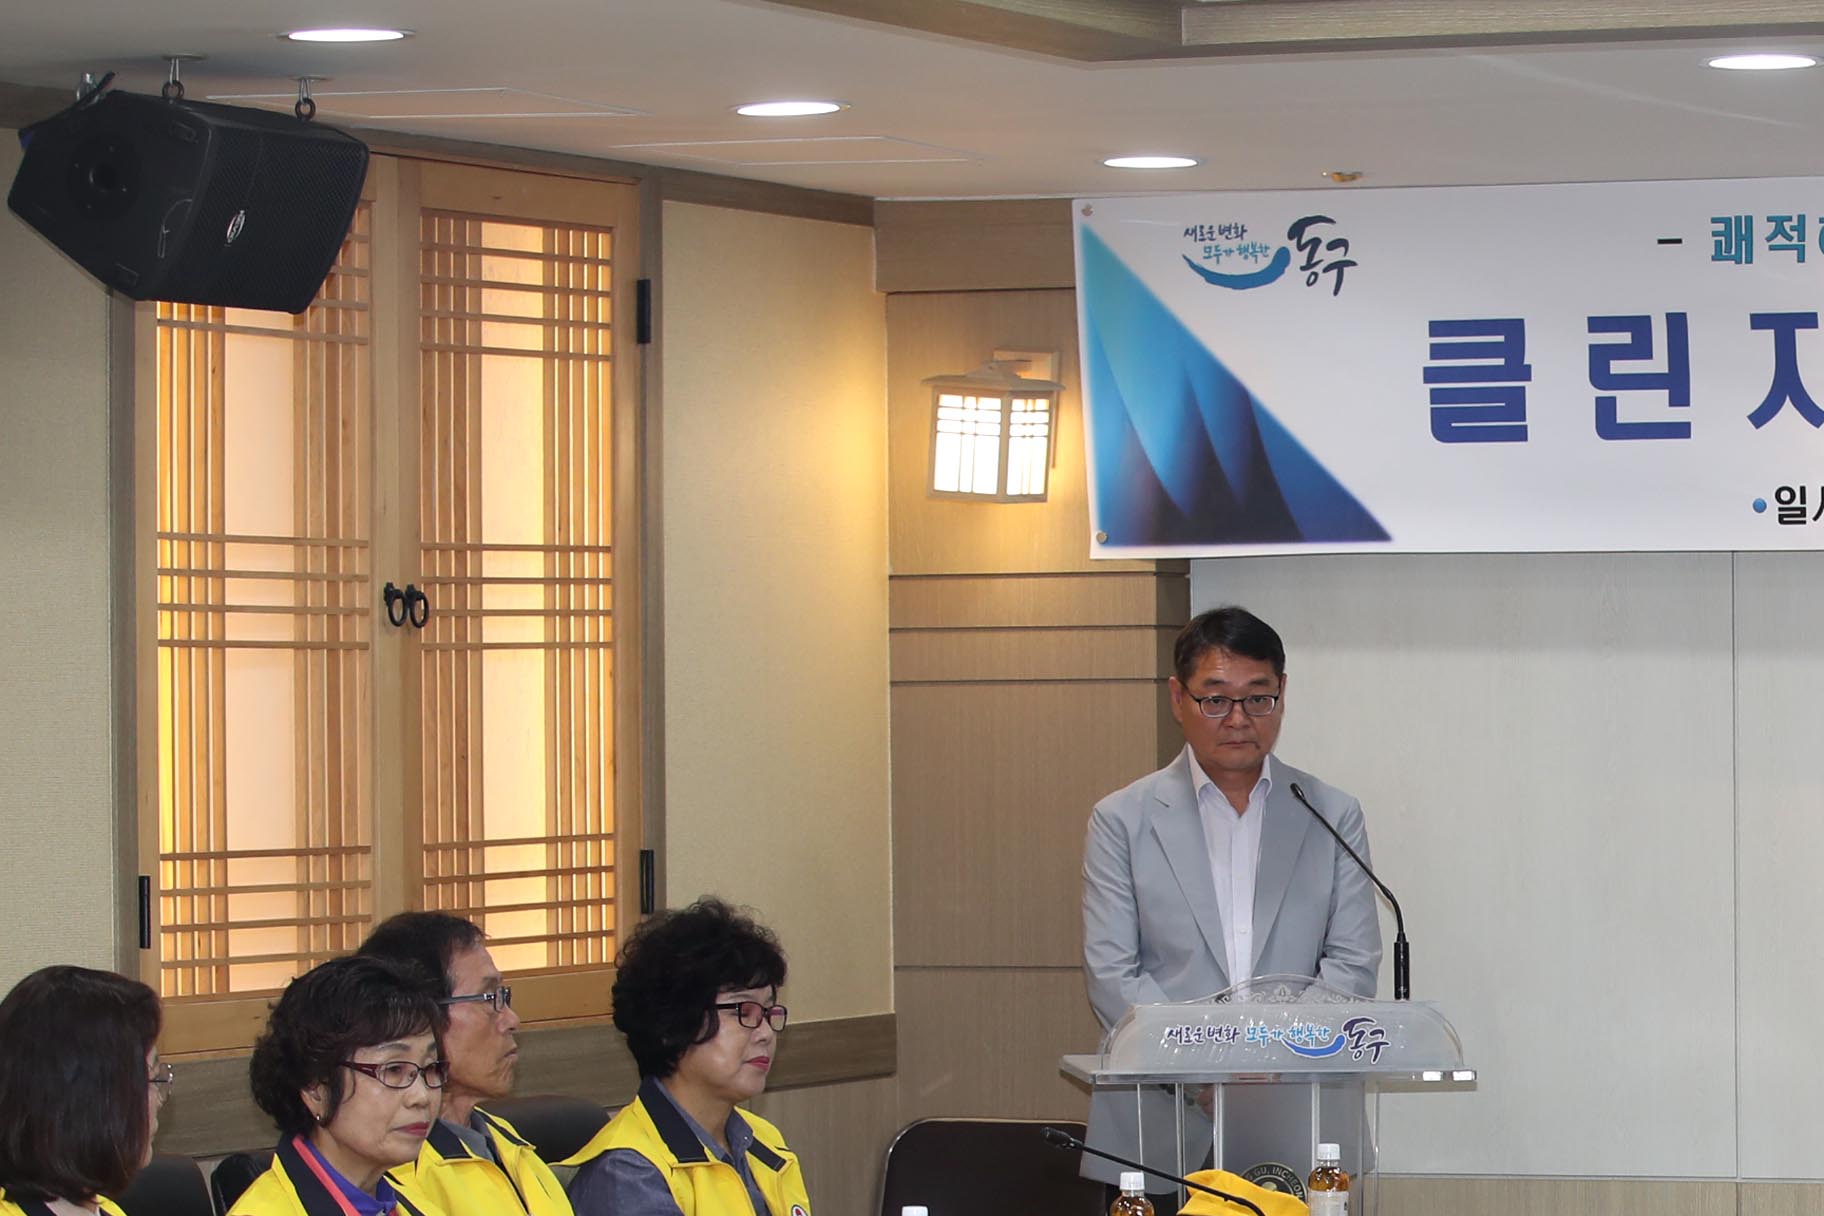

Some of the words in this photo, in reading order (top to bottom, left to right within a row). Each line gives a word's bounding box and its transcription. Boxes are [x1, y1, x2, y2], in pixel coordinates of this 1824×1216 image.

[1184, 224, 1217, 242] 새로운
[1218, 222, 1248, 241] 변화
[1202, 243, 1235, 265] 모두가
[1236, 241, 1271, 264] 행복한
[1287, 214, 1359, 297] 동구
[1166, 1024, 1204, 1044] 새로운
[1207, 1024, 1240, 1044] 변화
[1246, 1025, 1283, 1048] 모두가
[1288, 1024, 1331, 1048] 행복한
[1342, 1017, 1389, 1063] 동구
